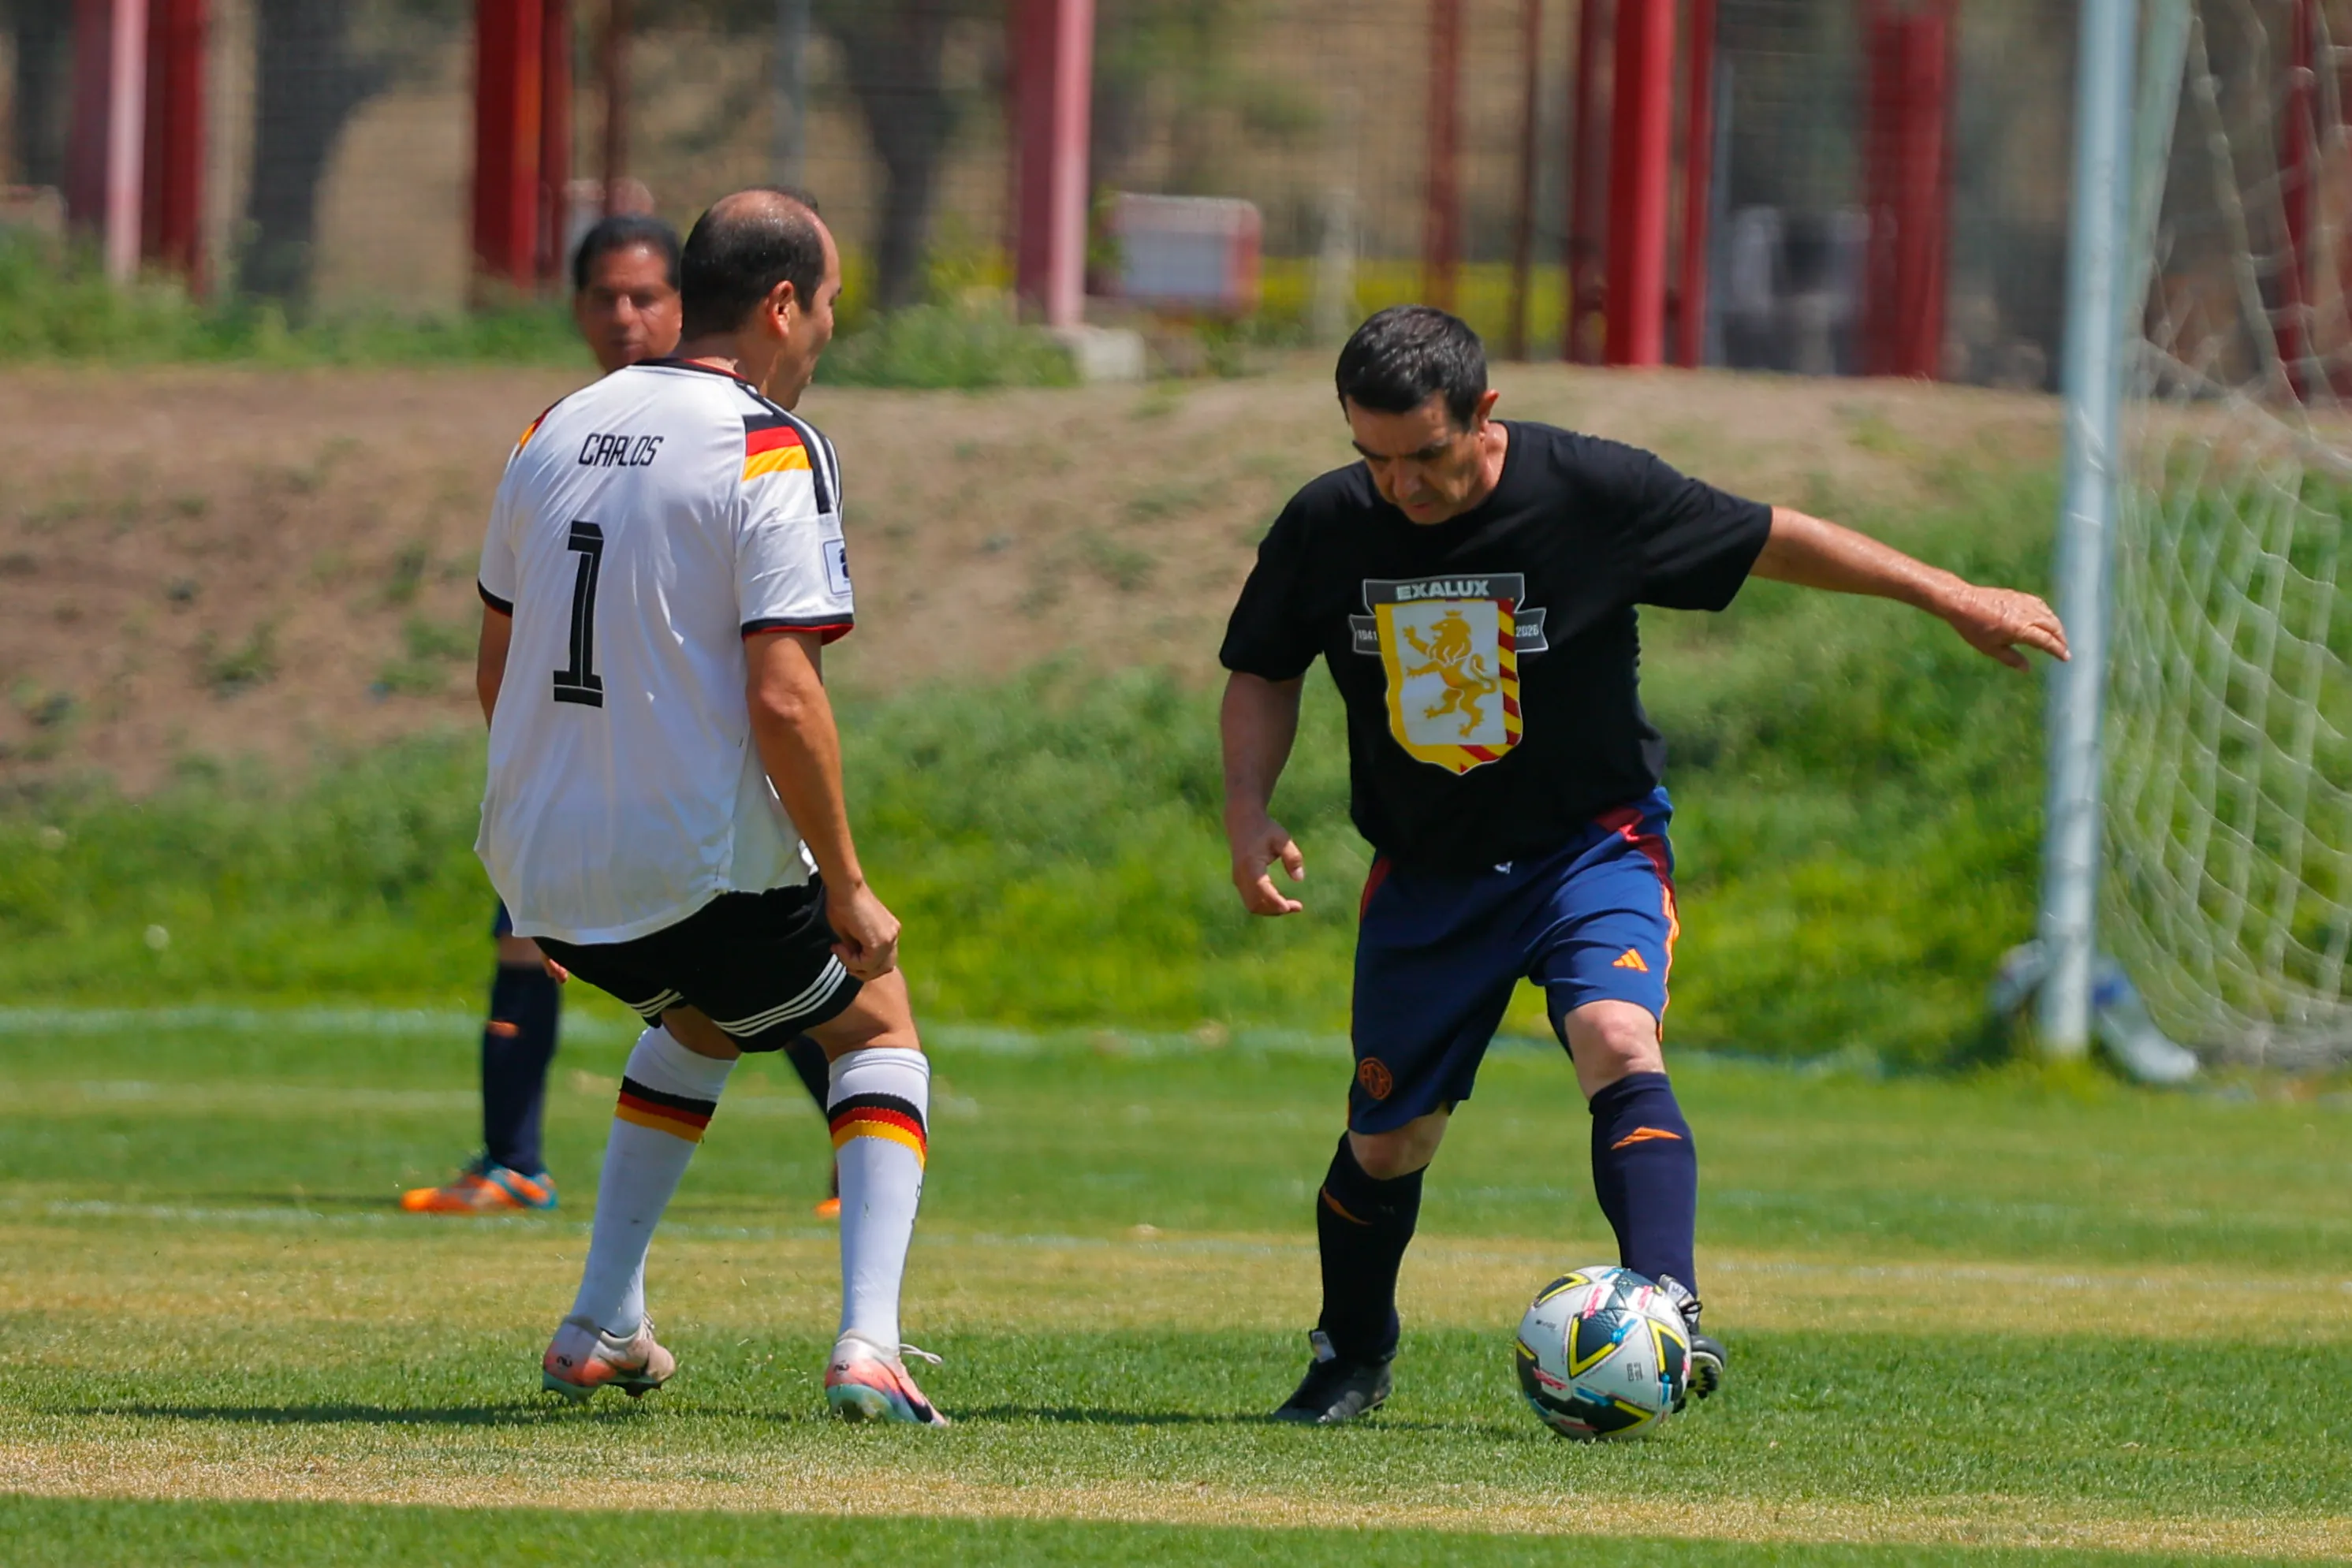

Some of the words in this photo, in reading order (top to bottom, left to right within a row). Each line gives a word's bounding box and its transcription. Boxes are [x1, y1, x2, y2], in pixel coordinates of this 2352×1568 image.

[578, 433, 664, 467] CARLOS
[1396, 580, 1489, 600] EXALUX
[554, 520, 604, 708] 1
